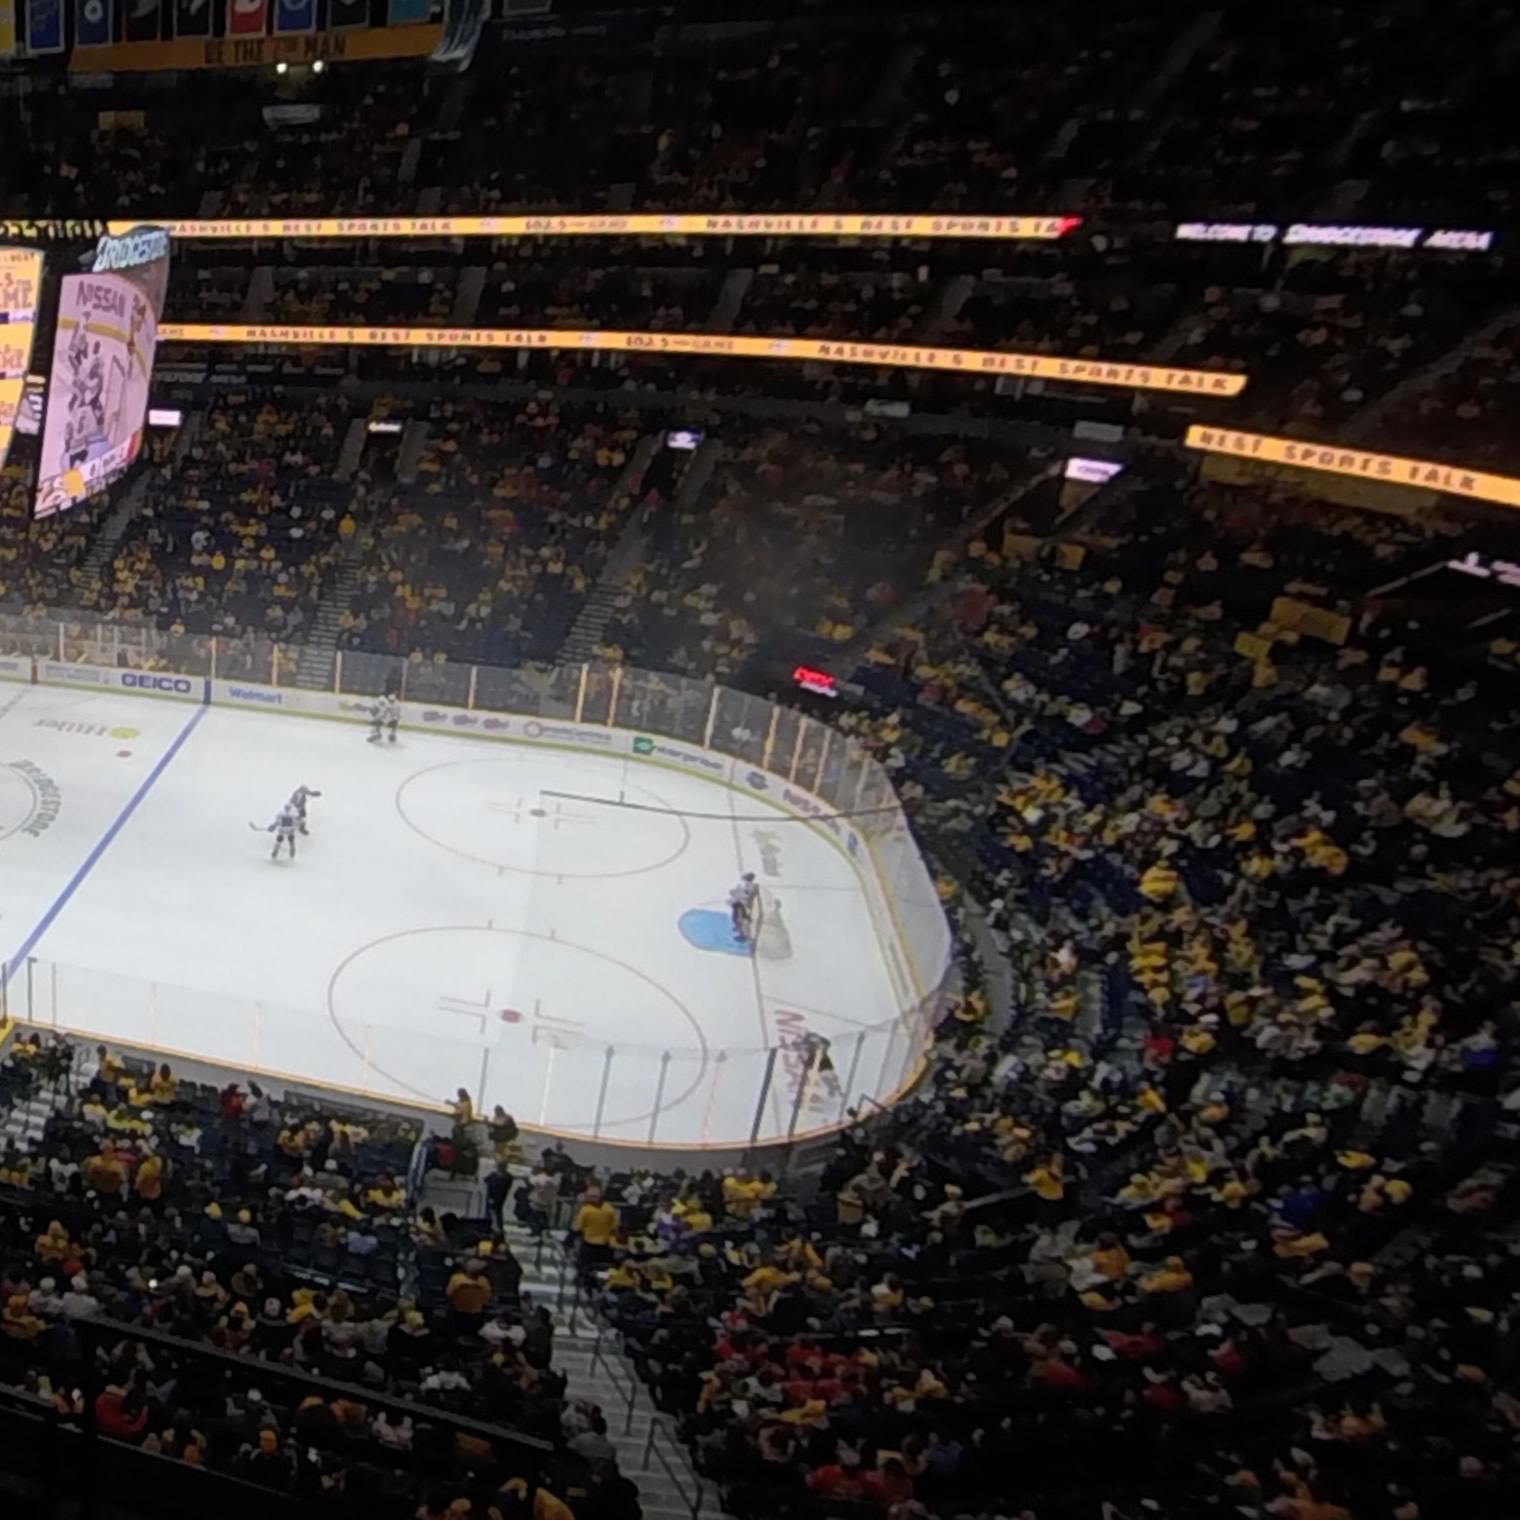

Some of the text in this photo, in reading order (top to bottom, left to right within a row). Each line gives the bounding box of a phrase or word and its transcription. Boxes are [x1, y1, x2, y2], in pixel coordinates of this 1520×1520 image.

[232, 39, 264, 62] THE
[304, 35, 346, 58] MAN
[282, 221, 323, 233] BEST
[337, 221, 401, 233] SPORTS
[411, 220, 452, 232] TALK
[860, 219, 914, 231] BEST
[931, 219, 1020, 232] SPORTS
[77, 281, 125, 317] NISSAN
[368, 330, 412, 342] BEST
[425, 331, 495, 344] SPORTS
[504, 333, 547, 345] TALK
[982, 357, 1040, 373] BEST
[1059, 361, 1152, 385] SPORTS
[1164, 372, 1228, 391] TALK
[1199, 430, 1478, 491] BEST SPORTS TALK
[121, 672, 192, 694] GEICO
[228, 687, 283, 704] Walmart
